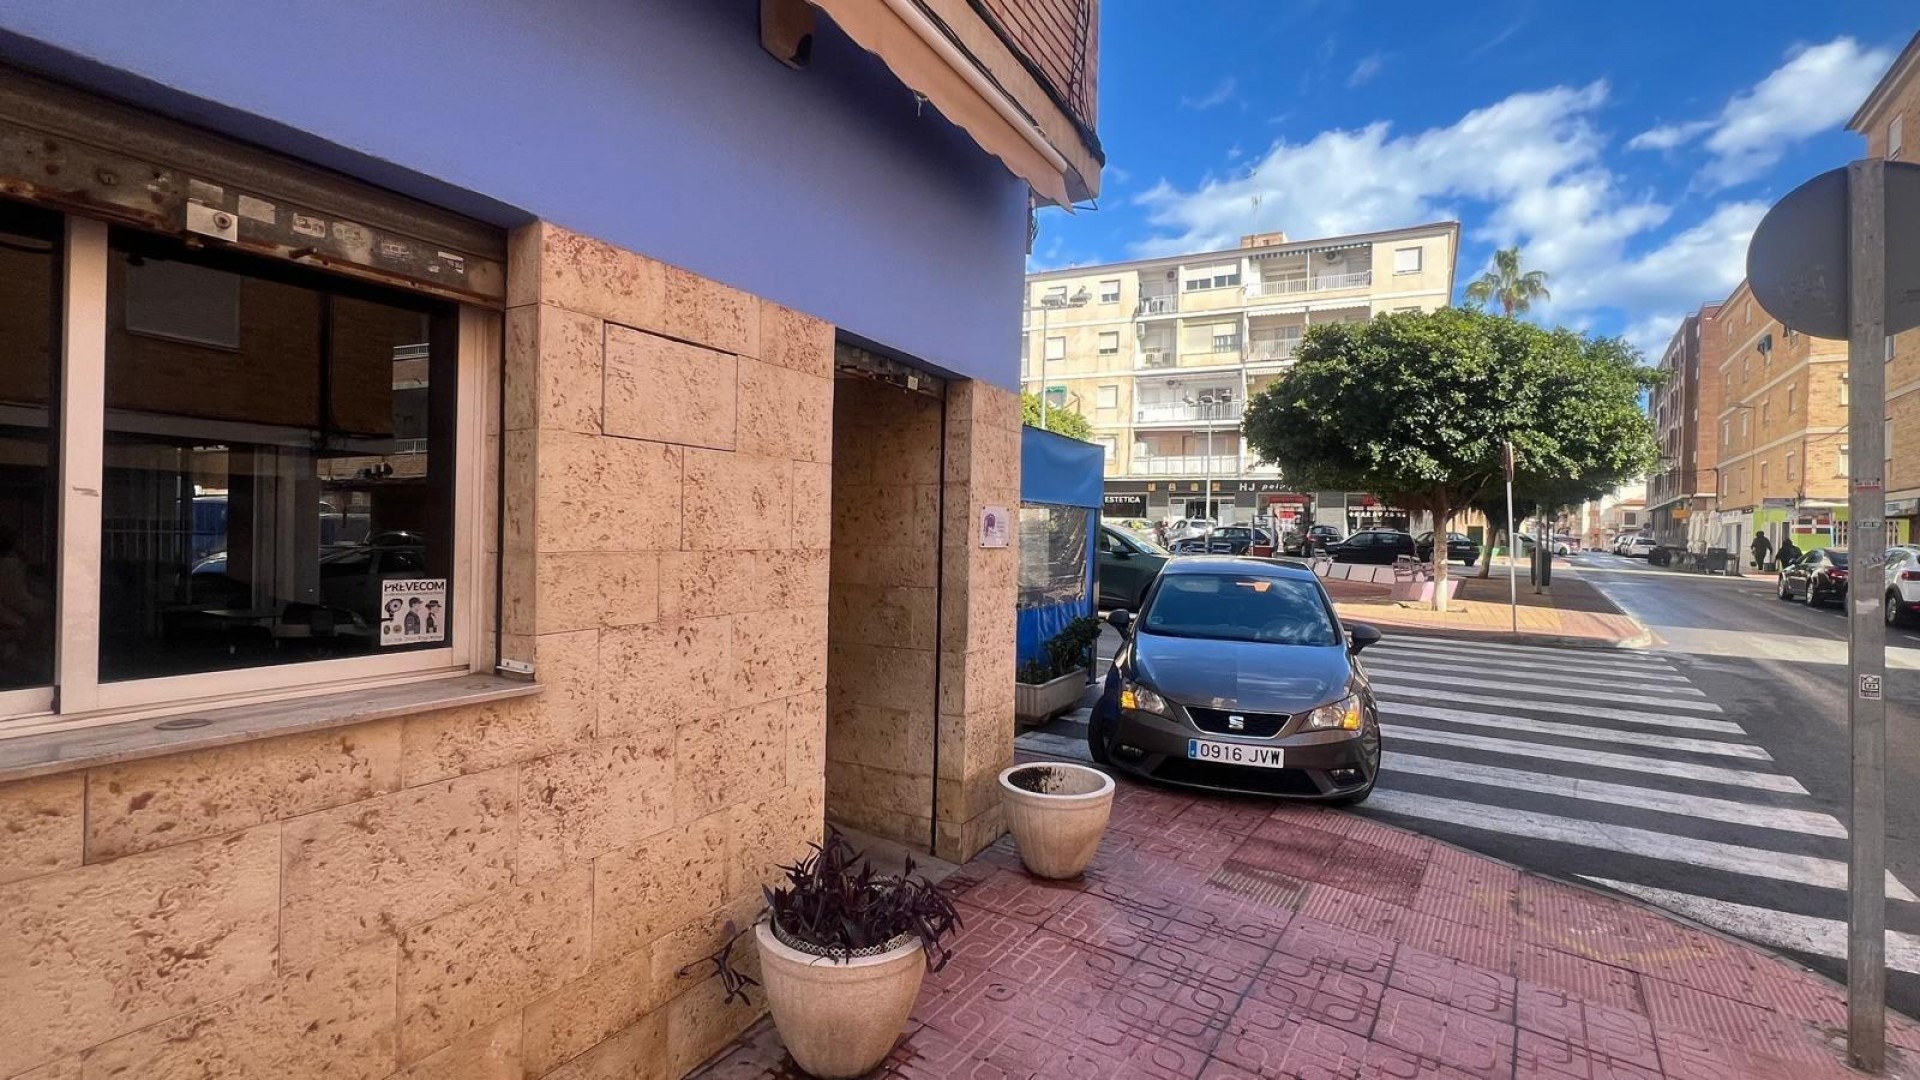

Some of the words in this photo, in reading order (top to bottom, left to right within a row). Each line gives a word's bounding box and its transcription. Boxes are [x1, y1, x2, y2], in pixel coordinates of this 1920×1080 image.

[384, 581, 445, 592] PREVECOM
[1200, 743, 1242, 761] 0916
[1249, 749, 1280, 765] JVW
